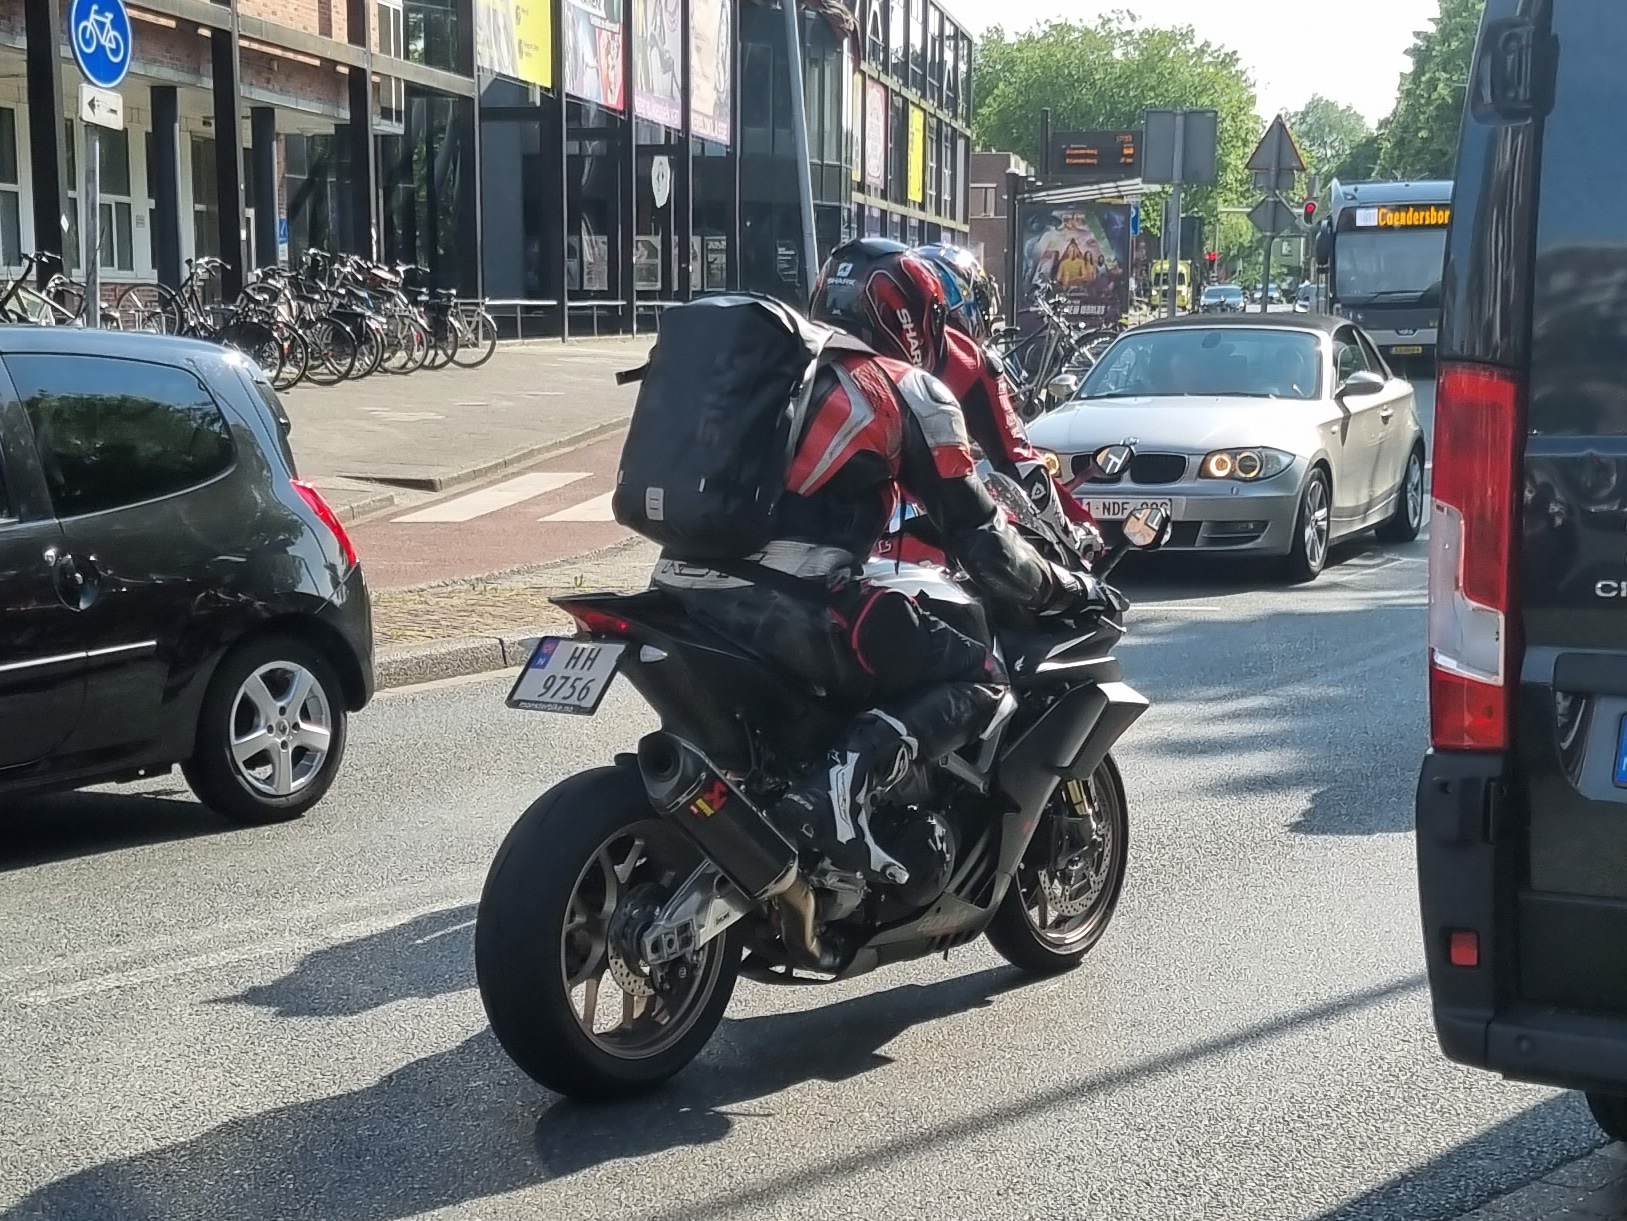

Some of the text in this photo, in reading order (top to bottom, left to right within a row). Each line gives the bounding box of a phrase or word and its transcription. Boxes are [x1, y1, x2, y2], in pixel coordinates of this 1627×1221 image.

[827, 277, 856, 286] SHARK
[564, 646, 602, 671] HH
[537, 674, 596, 702] 9756
